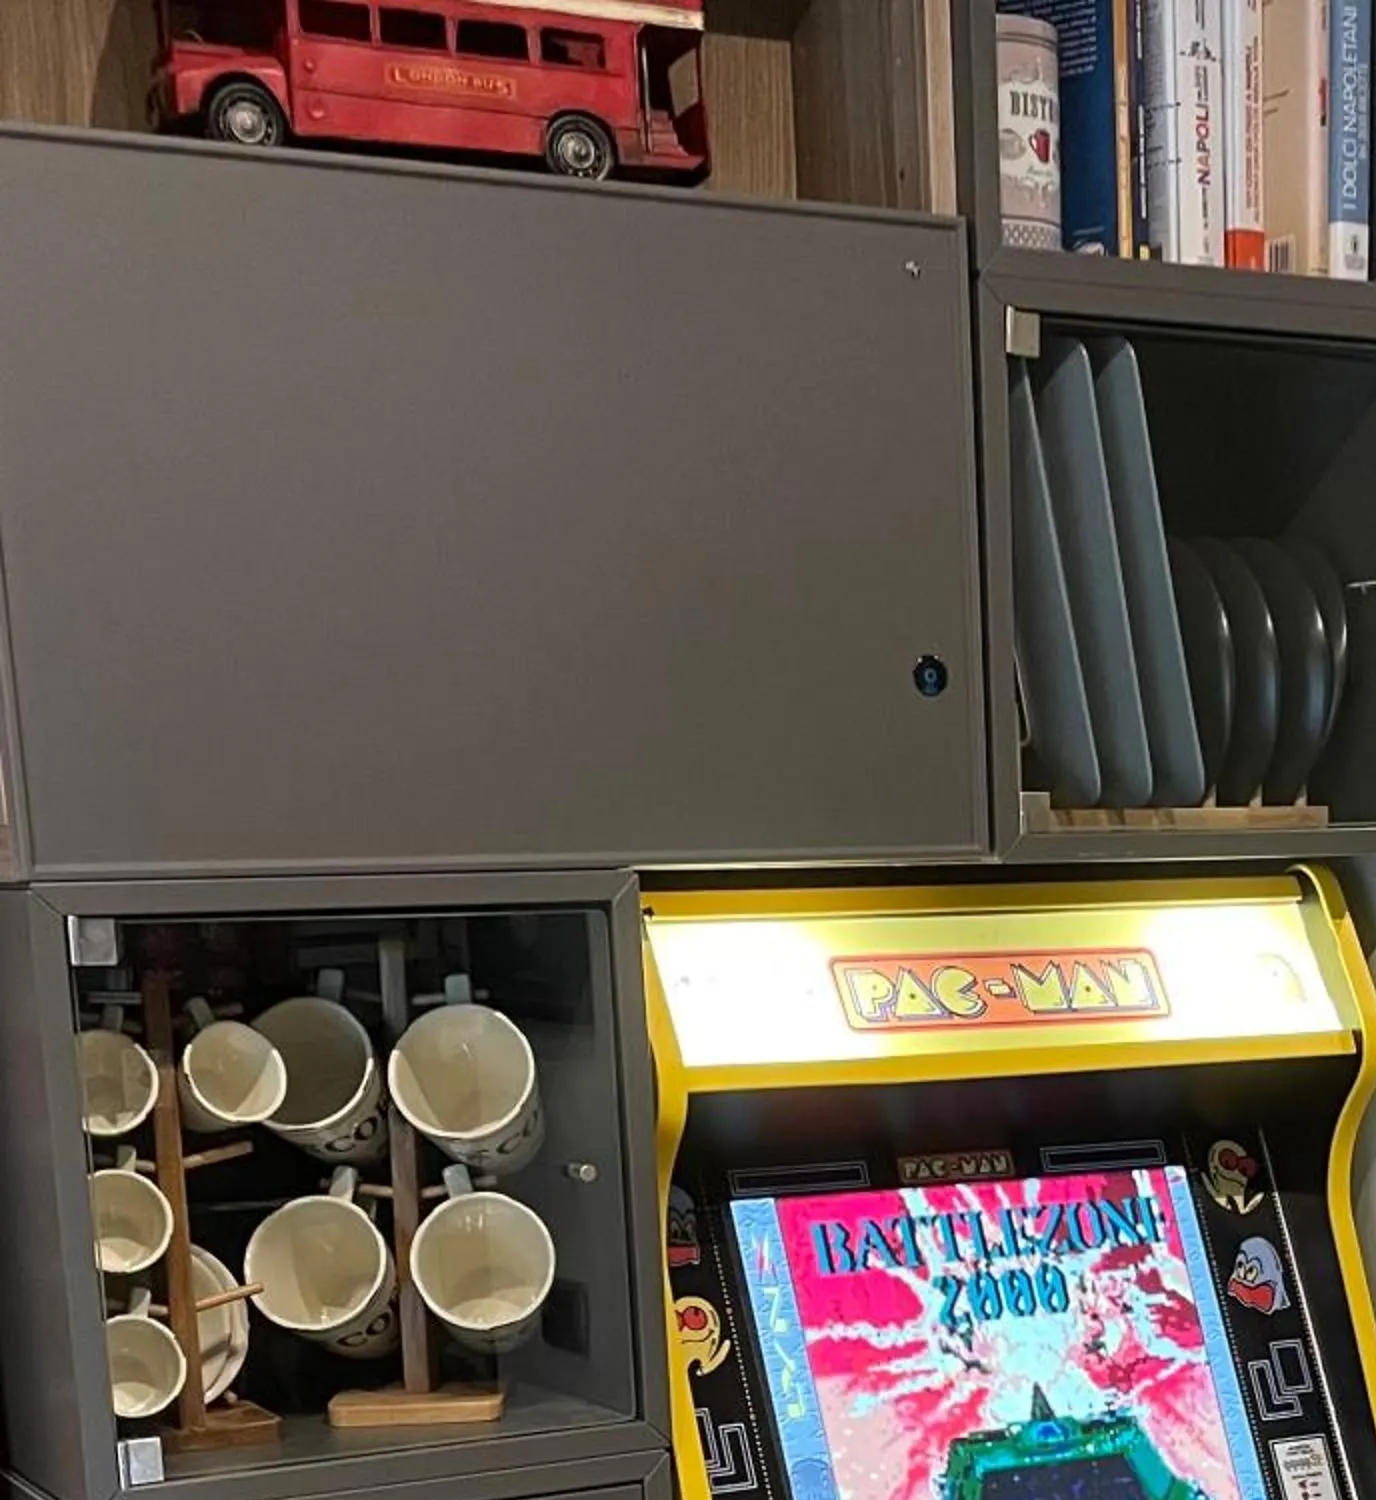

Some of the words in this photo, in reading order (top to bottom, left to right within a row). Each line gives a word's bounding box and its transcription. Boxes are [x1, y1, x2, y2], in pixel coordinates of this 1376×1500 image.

[394, 67, 468, 87] LONDON
[473, 77, 512, 95] BUS
[1342, 5, 1359, 132] NAPOLETANI
[1195, 102, 1212, 186] NAPOLI
[850, 957, 1158, 1022] PAC-MAN
[901, 1152, 1011, 1181] PAC-MAN
[810, 1195, 1166, 1277] BATTLEZONE
[931, 1262, 1070, 1339] 2000
